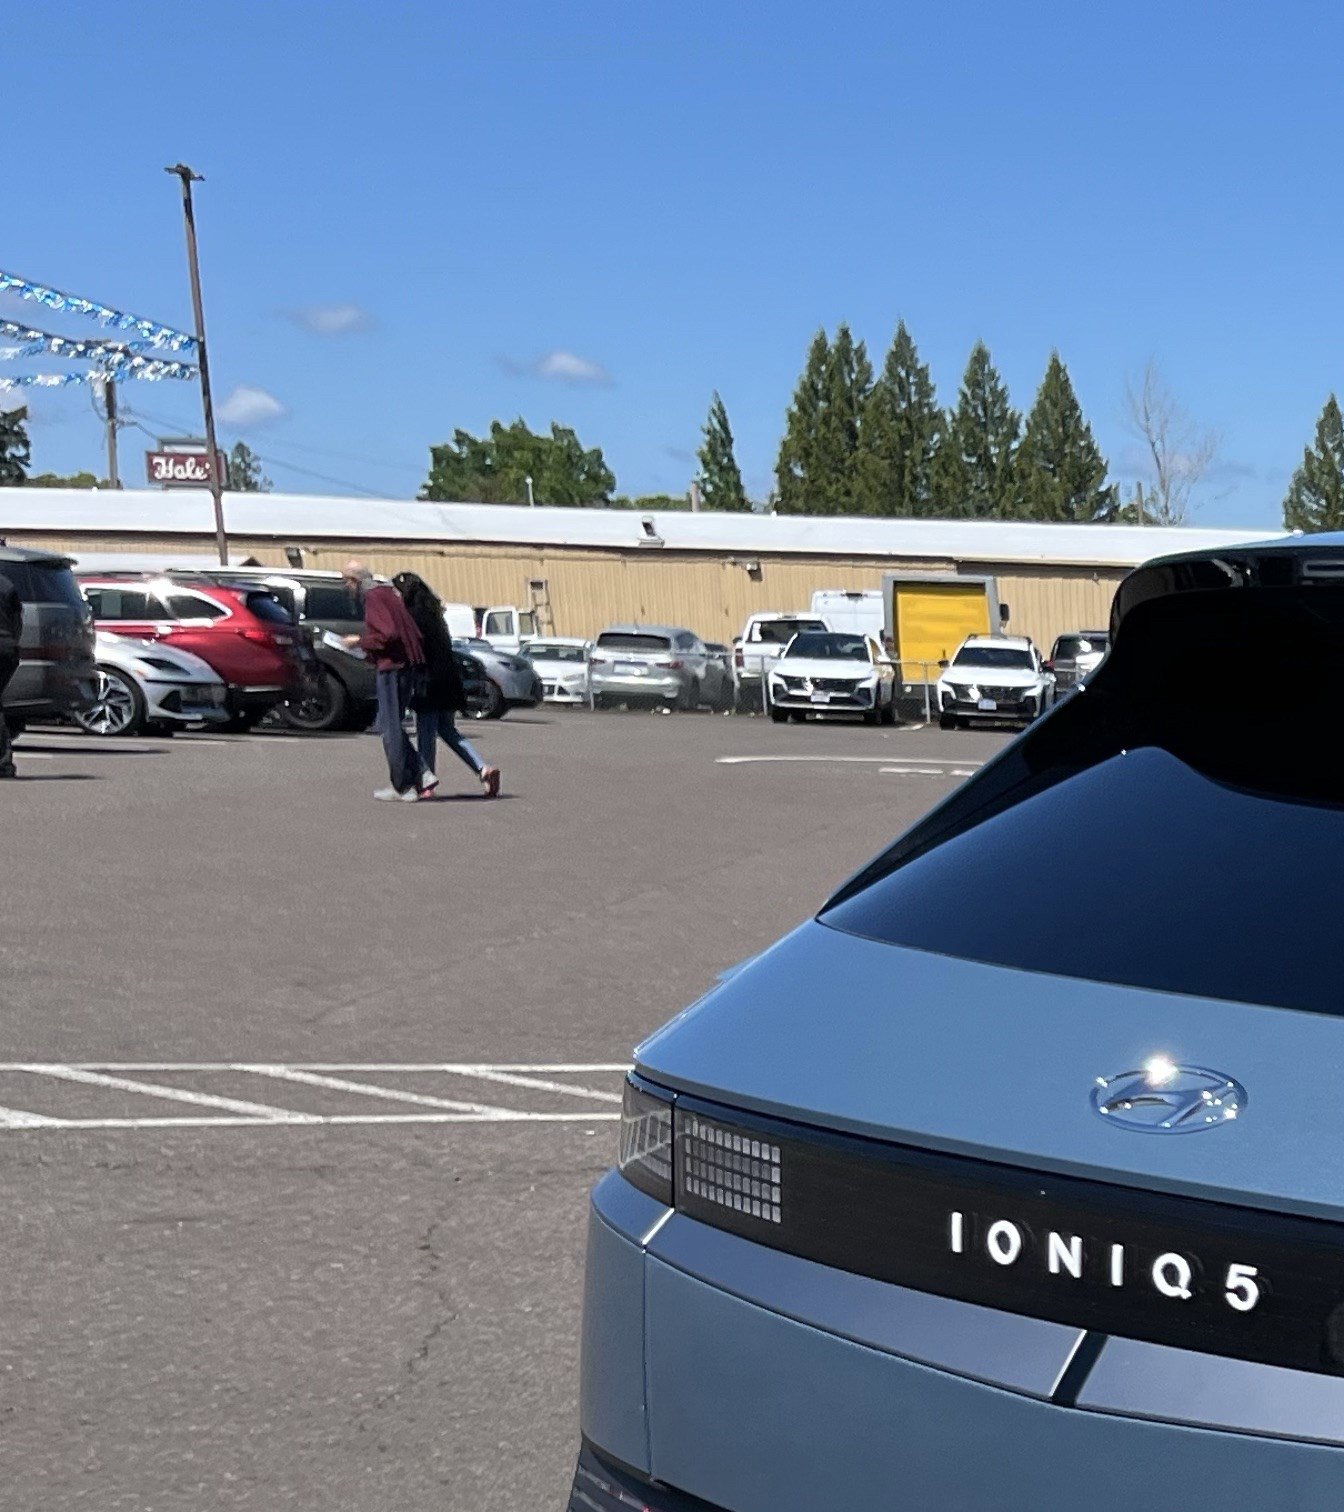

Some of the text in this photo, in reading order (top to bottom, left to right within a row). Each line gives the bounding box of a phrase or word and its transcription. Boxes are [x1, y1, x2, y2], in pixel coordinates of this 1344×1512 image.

[152, 456, 210, 480] Hale'
[950, 1211, 1260, 1312] IONIQ 5
